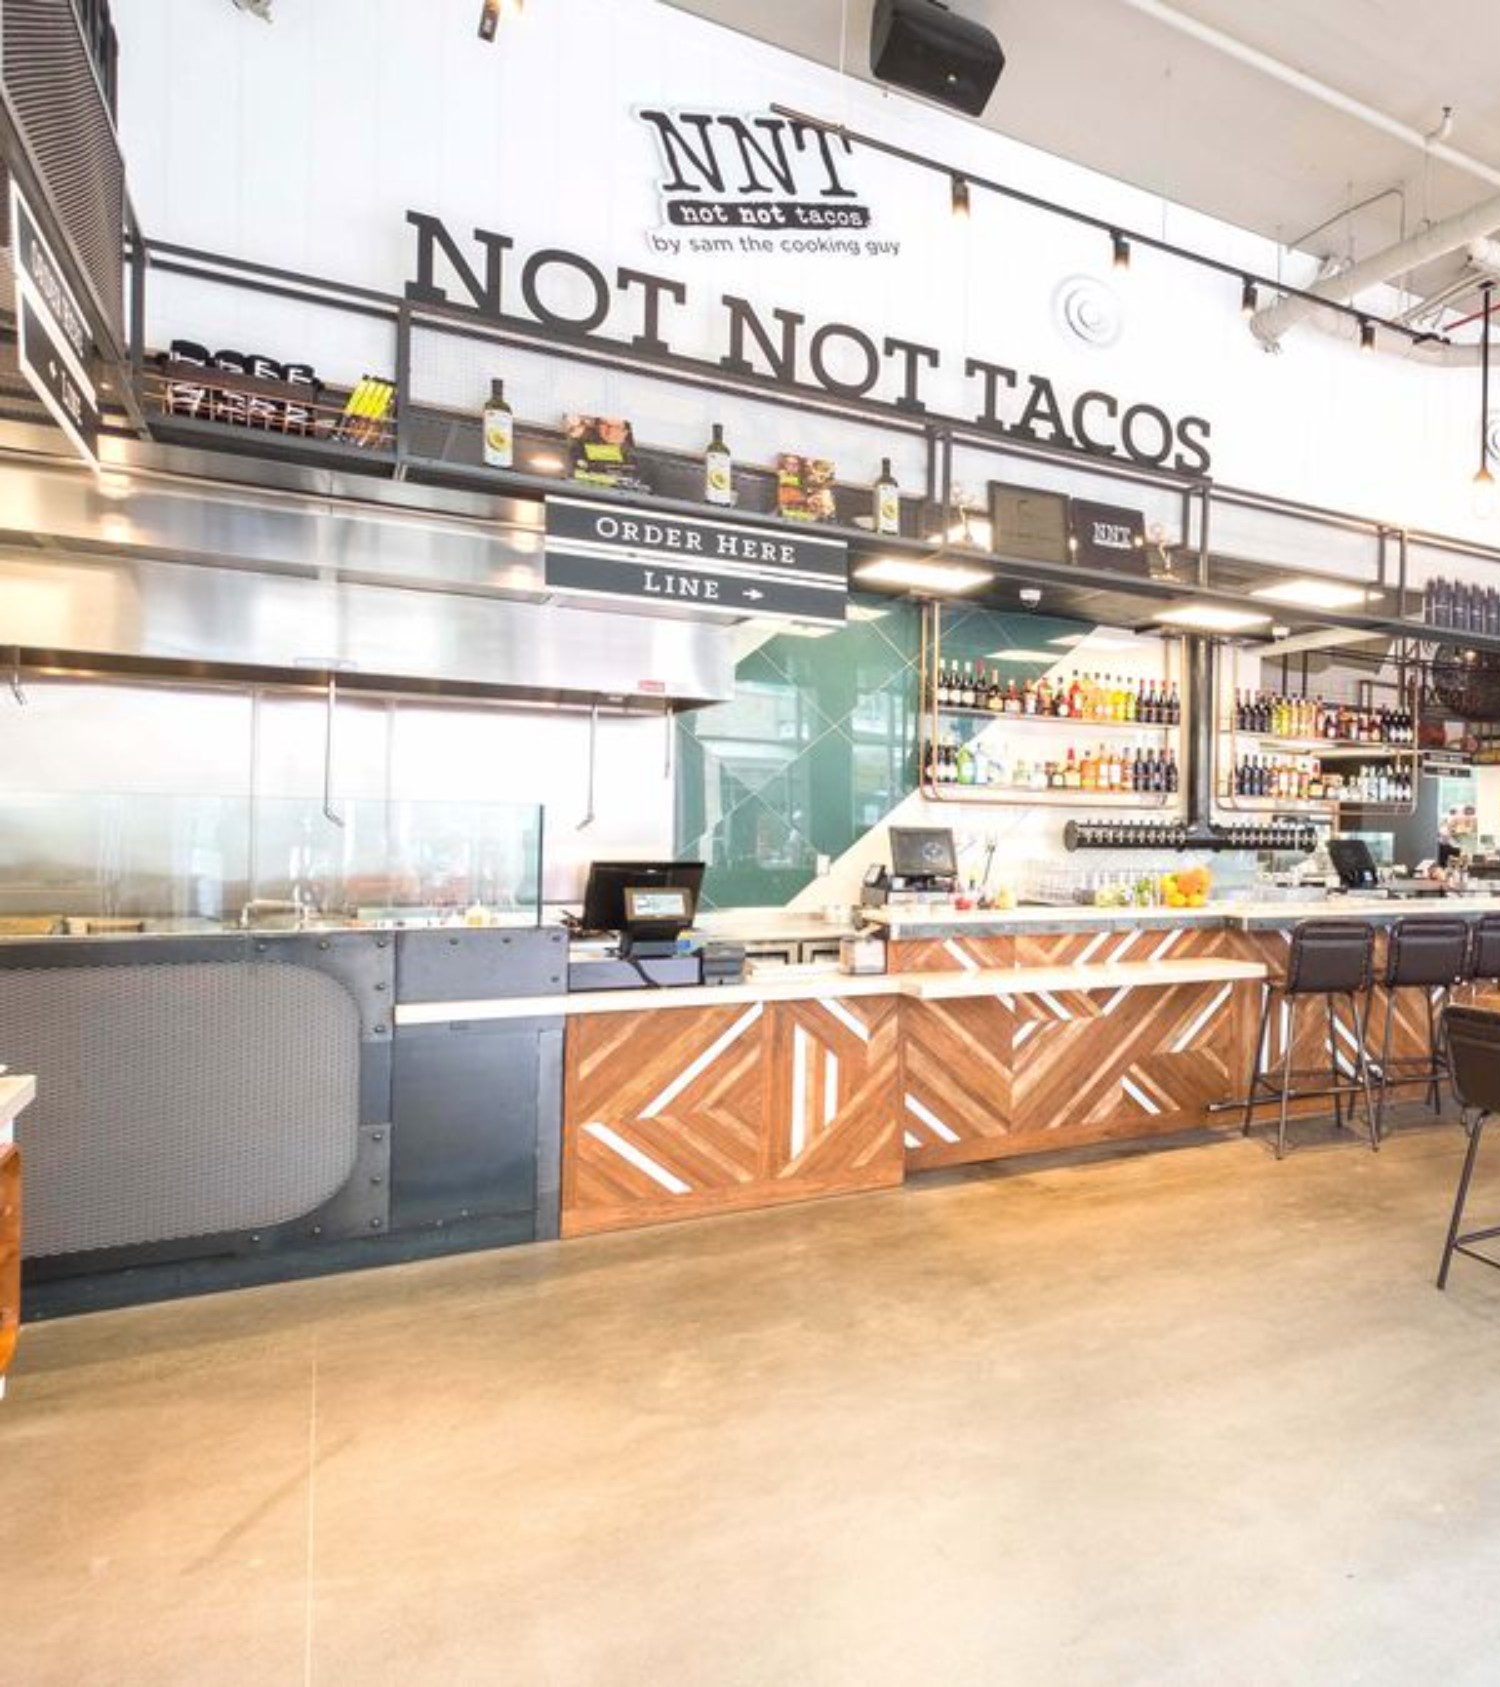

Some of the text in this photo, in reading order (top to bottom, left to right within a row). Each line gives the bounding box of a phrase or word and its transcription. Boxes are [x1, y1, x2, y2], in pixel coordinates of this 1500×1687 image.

[640, 109, 858, 198] NNT
[679, 205, 864, 227] not not tacos
[651, 235, 902, 256] by sam the cooking guy
[404, 209, 1212, 475] NOT NOT TACOS
[596, 516, 797, 564] ORDER HERE
[643, 571, 721, 600] LINE
